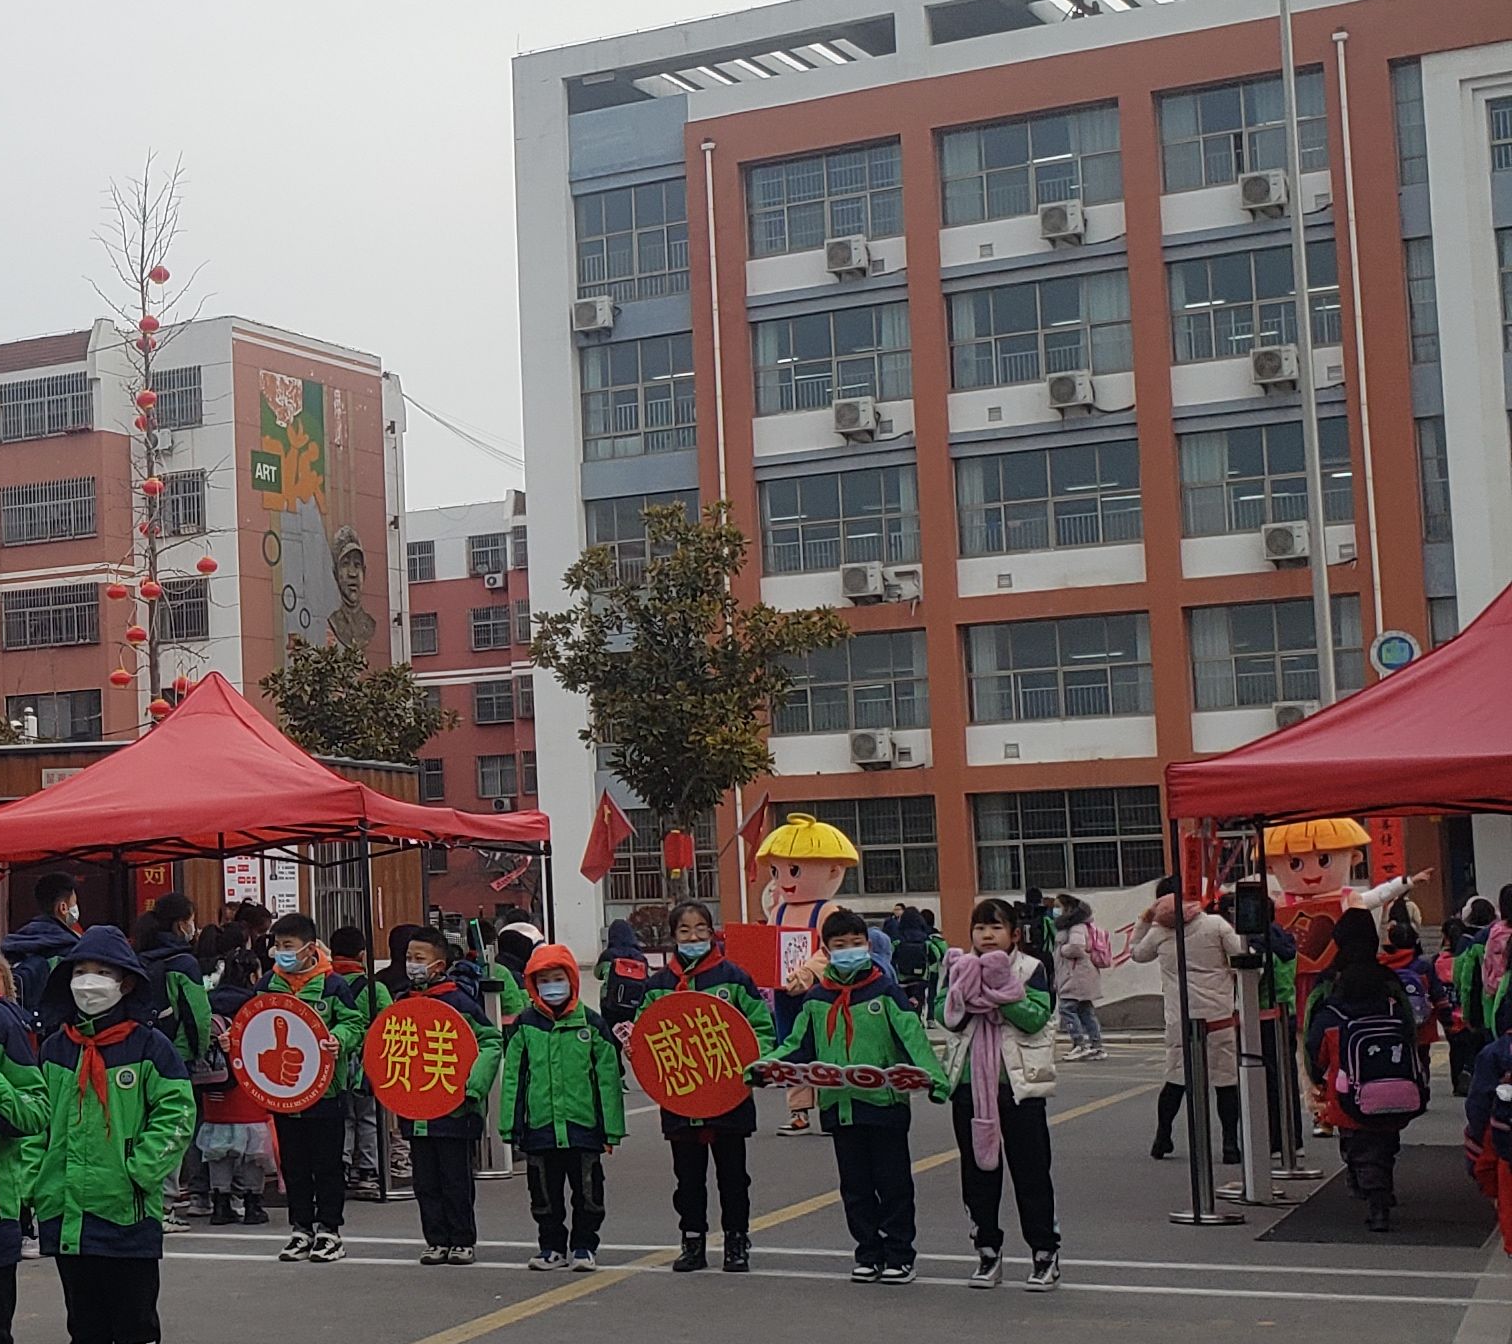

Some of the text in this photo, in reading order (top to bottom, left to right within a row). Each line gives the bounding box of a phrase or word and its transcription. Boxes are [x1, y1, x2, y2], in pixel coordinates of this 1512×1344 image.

[254, 462, 278, 484] ART
[378, 1014, 459, 1094] 赞美
[644, 1004, 743, 1097] 感谢
